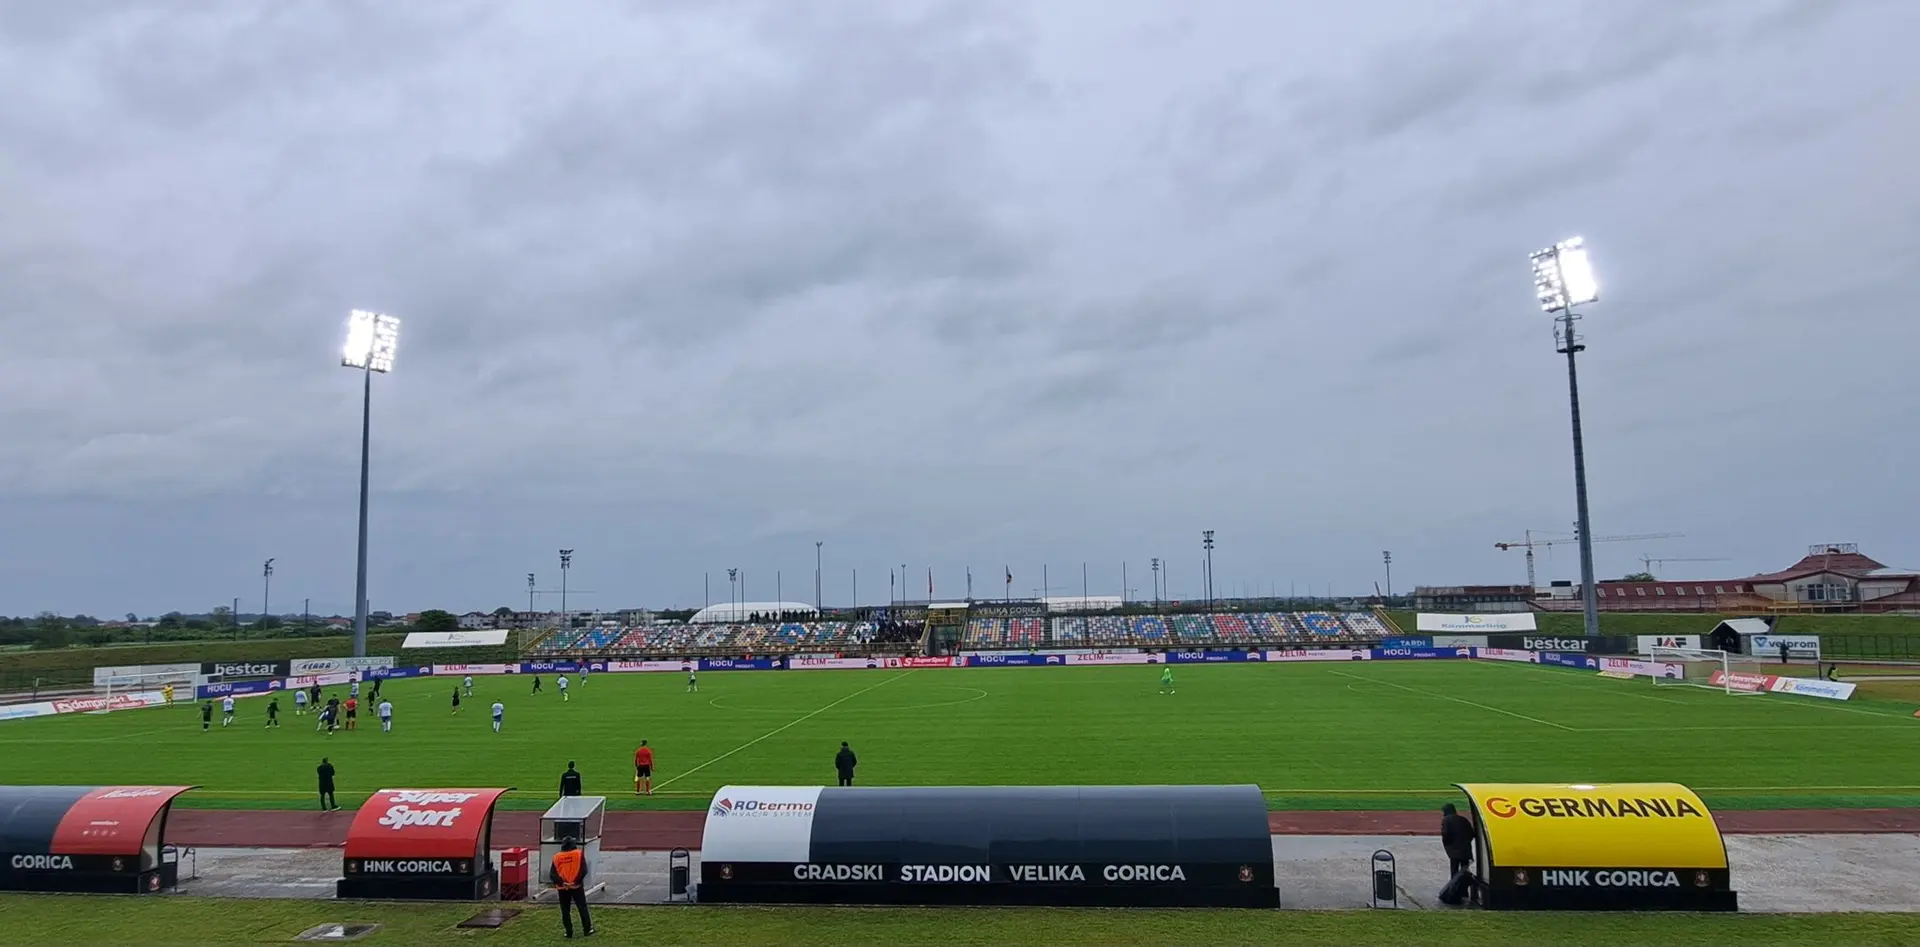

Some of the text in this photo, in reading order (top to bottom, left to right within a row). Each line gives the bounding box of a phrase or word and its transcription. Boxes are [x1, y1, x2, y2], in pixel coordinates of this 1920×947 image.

[978, 606, 1042, 616] VELIKA GORICA
[1523, 637, 1589, 650] bestcar
[1652, 637, 1687, 648] JAF
[1769, 641, 1817, 650] veprom
[215, 662, 278, 676] bestcar
[389, 791, 479, 806] Super
[734, 800, 813, 811] ROtermo
[1519, 797, 1703, 818] GERMANIA
[379, 804, 462, 830] Sport
[11, 854, 74, 870] GORICA
[363, 860, 453, 873] HNK GORICA
[793, 864, 1187, 882] GRADSKI STADION VELIKA GORICA
[1541, 869, 1681, 888] HNK GORICA
